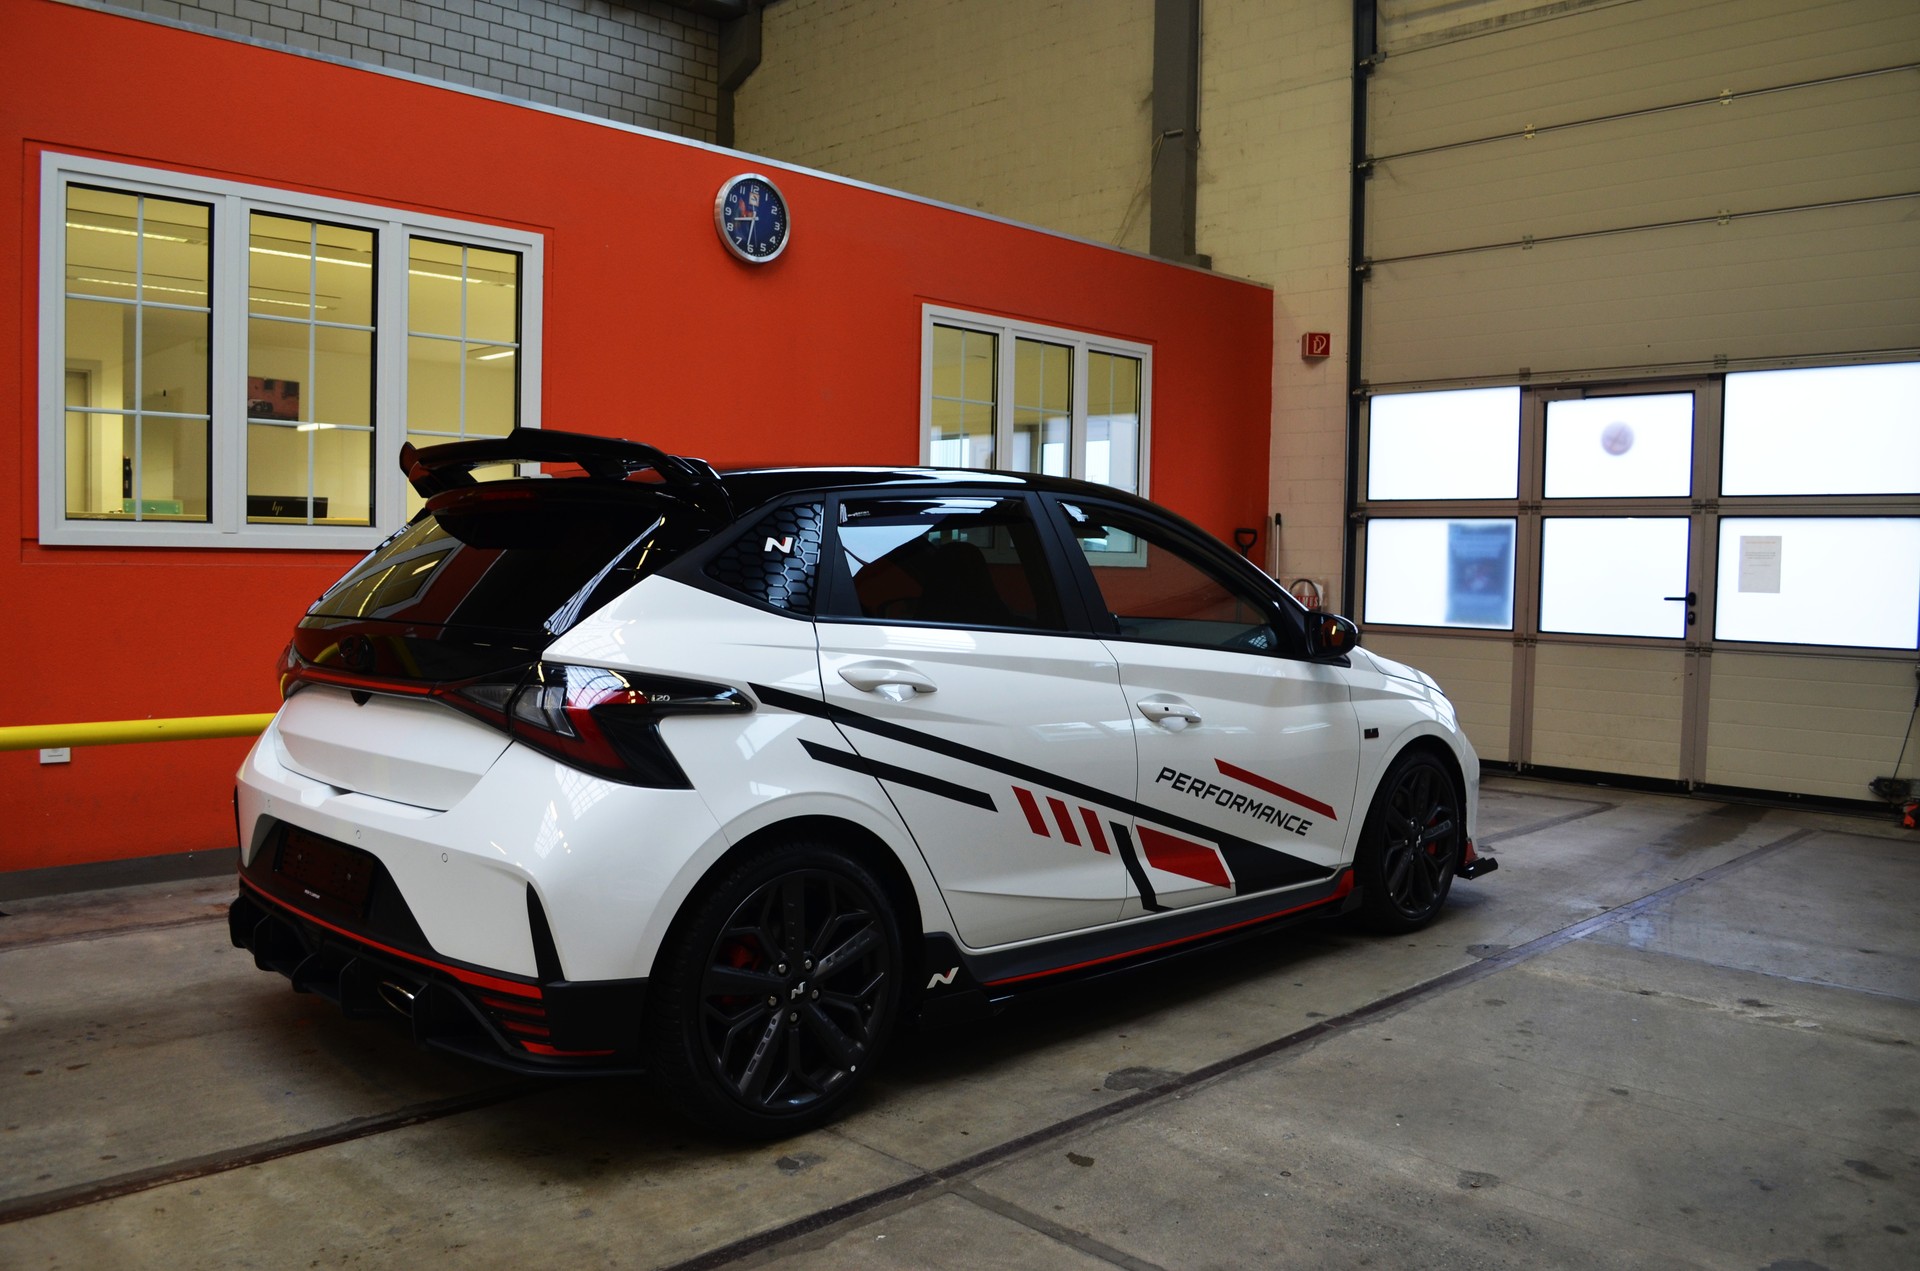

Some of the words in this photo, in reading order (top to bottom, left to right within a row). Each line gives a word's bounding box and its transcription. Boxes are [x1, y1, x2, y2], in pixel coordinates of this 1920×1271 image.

[739, 185, 746, 195] 11
[750, 185, 760, 195] 12
[729, 193, 738, 203] 10
[725, 207, 732, 216] 9
[771, 205, 778, 215] 2
[726, 222, 734, 232] 8
[774, 222, 780, 231] 3
[735, 236, 742, 245] 7
[769, 235, 776, 244] 4
[747, 244, 754, 253] 6
[760, 243, 767, 252] 5
[651, 694, 671, 702] i20
[1155, 766, 1313, 836] PERFORMANCE
